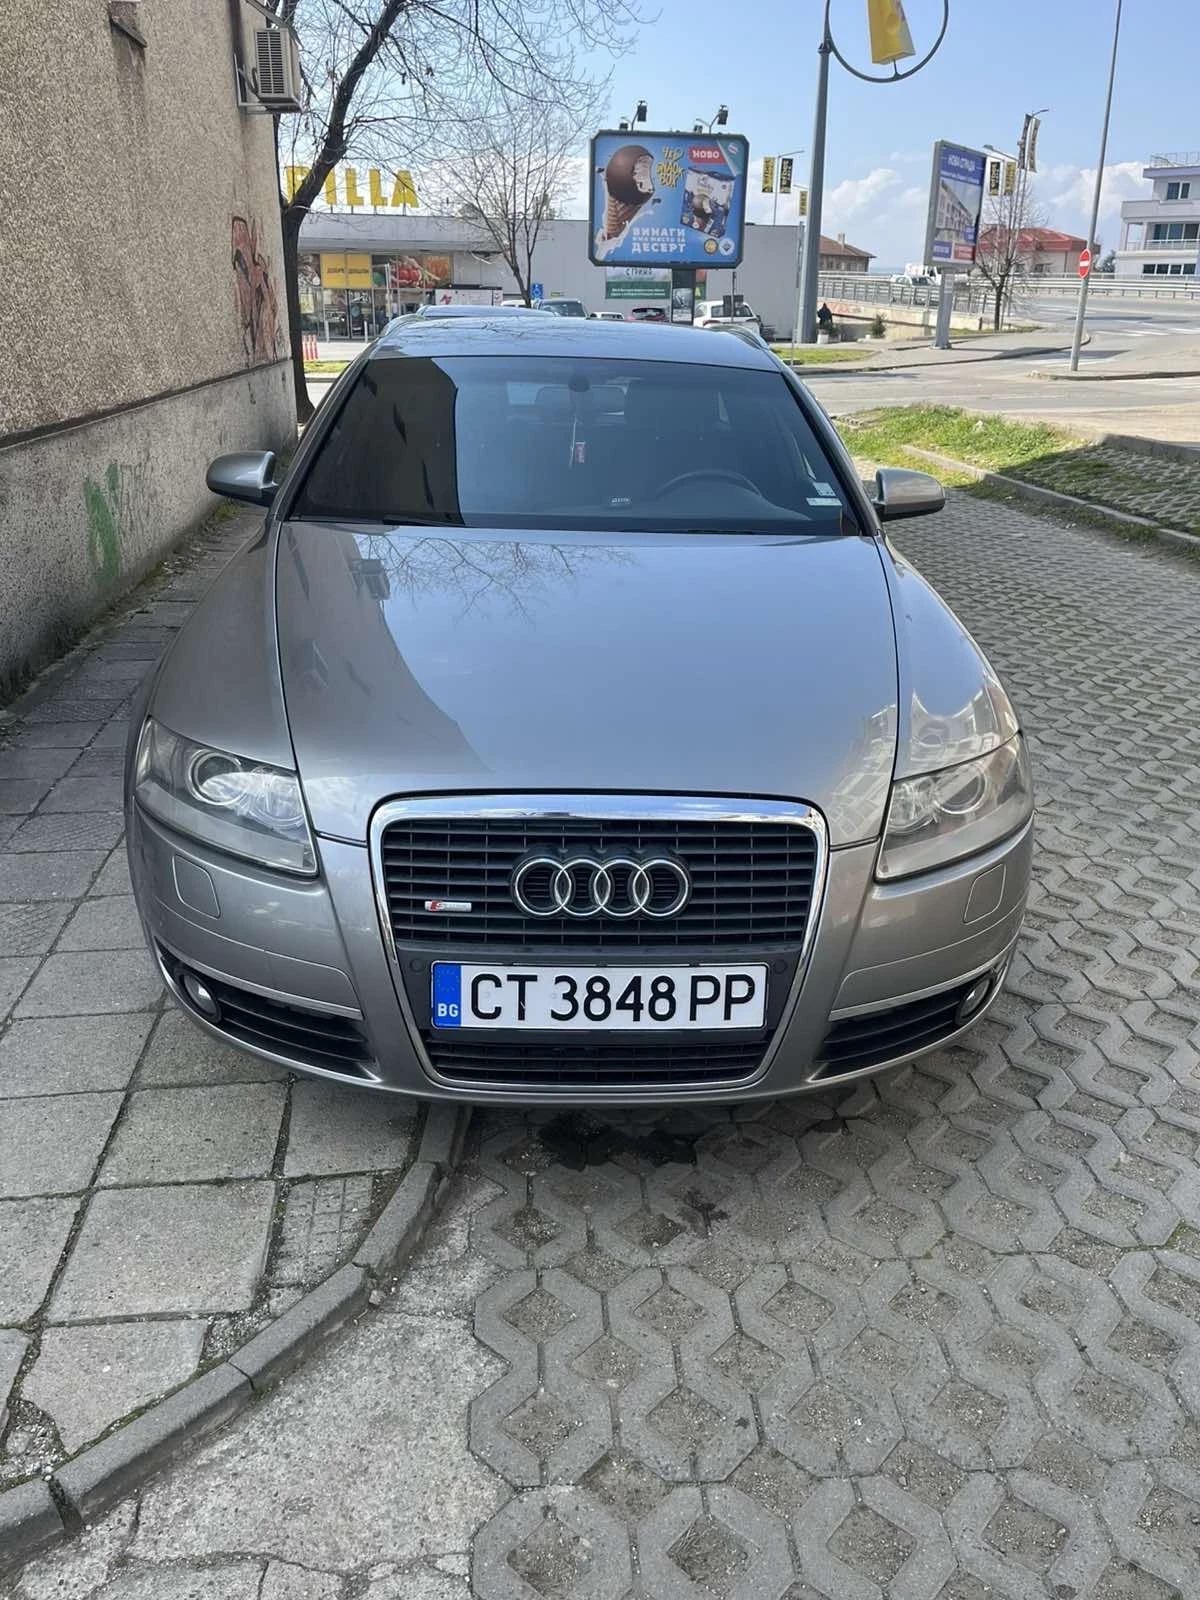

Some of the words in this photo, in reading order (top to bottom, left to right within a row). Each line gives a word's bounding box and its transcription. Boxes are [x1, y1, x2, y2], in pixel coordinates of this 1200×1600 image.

[631, 242, 686, 254] ДЕСЕРТ
[550, 974, 677, 1023] 3848
[437, 1003, 459, 1018] BG
